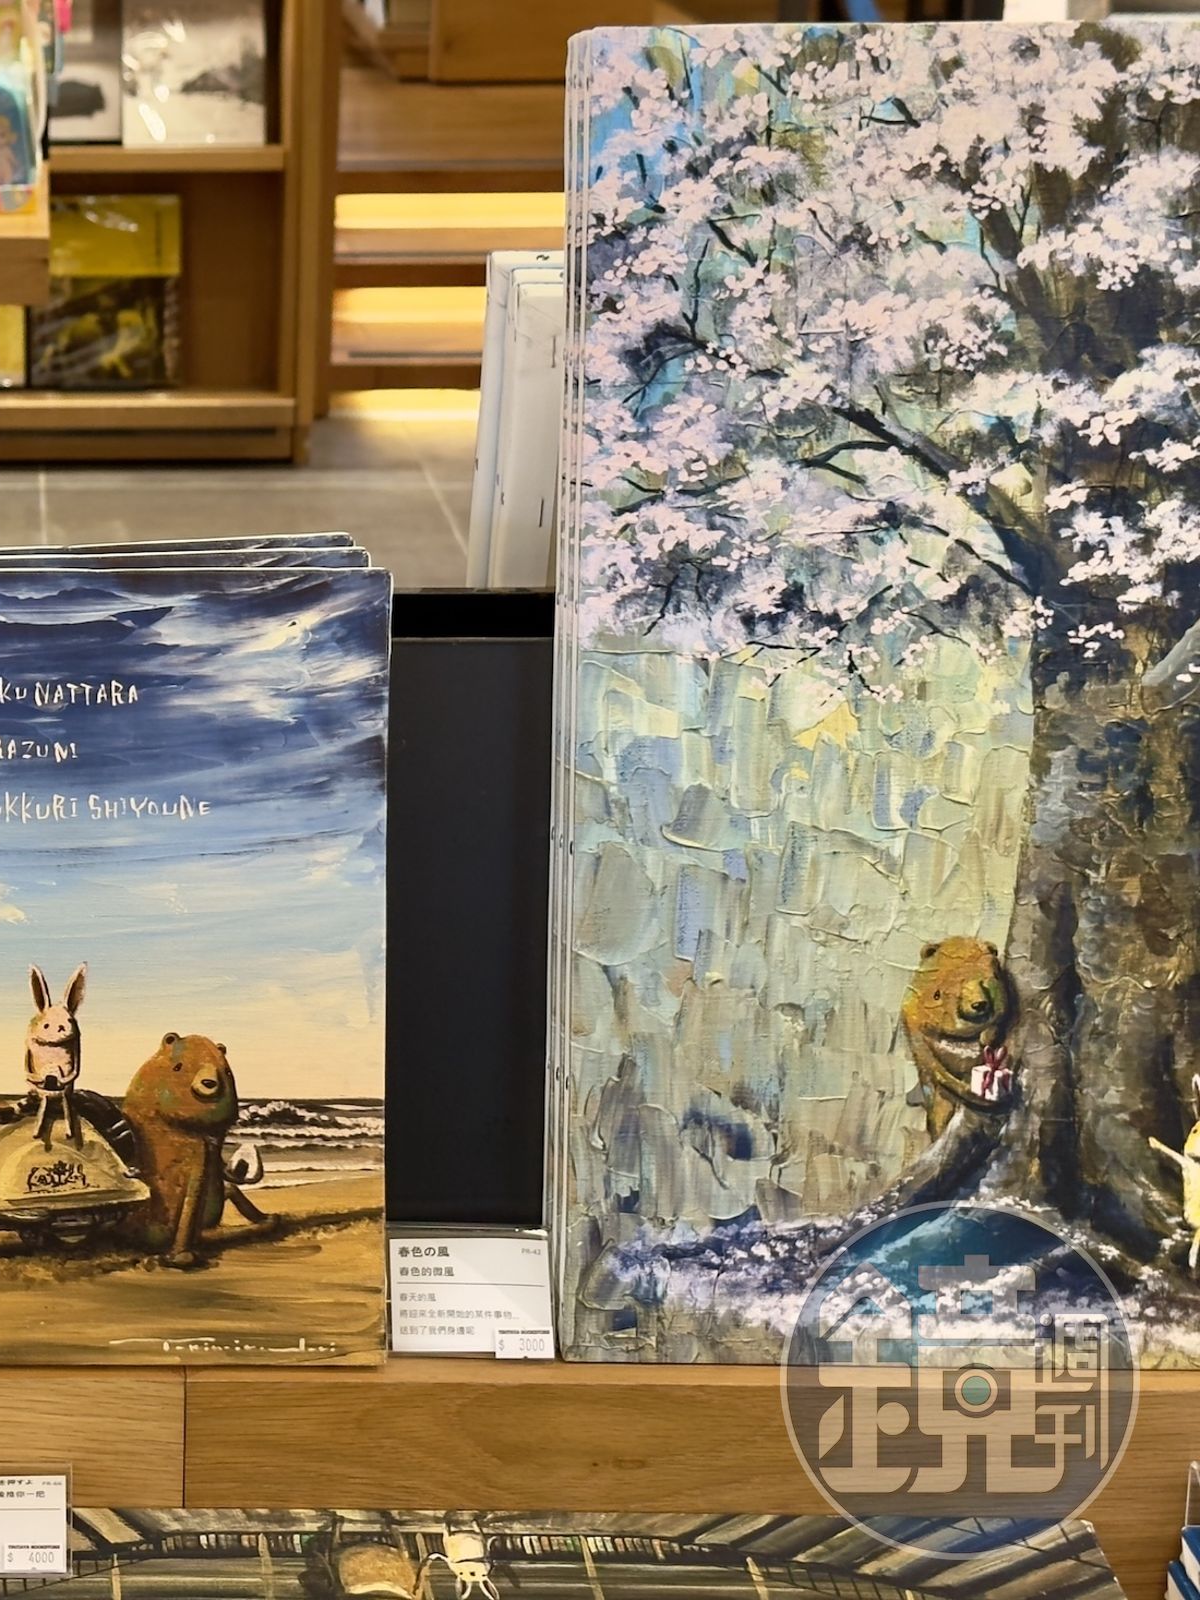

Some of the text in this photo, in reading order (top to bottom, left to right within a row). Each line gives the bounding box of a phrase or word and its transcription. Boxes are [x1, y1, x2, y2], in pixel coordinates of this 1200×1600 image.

[398, 1246, 450, 1257] 春色の風
[399, 1266, 455, 1277] 春色的微風
[399, 1293, 437, 1302] 春天的風
[498, 1338, 545, 1351] $ 3000
[7, 1551, 55, 1563] $ 4000
